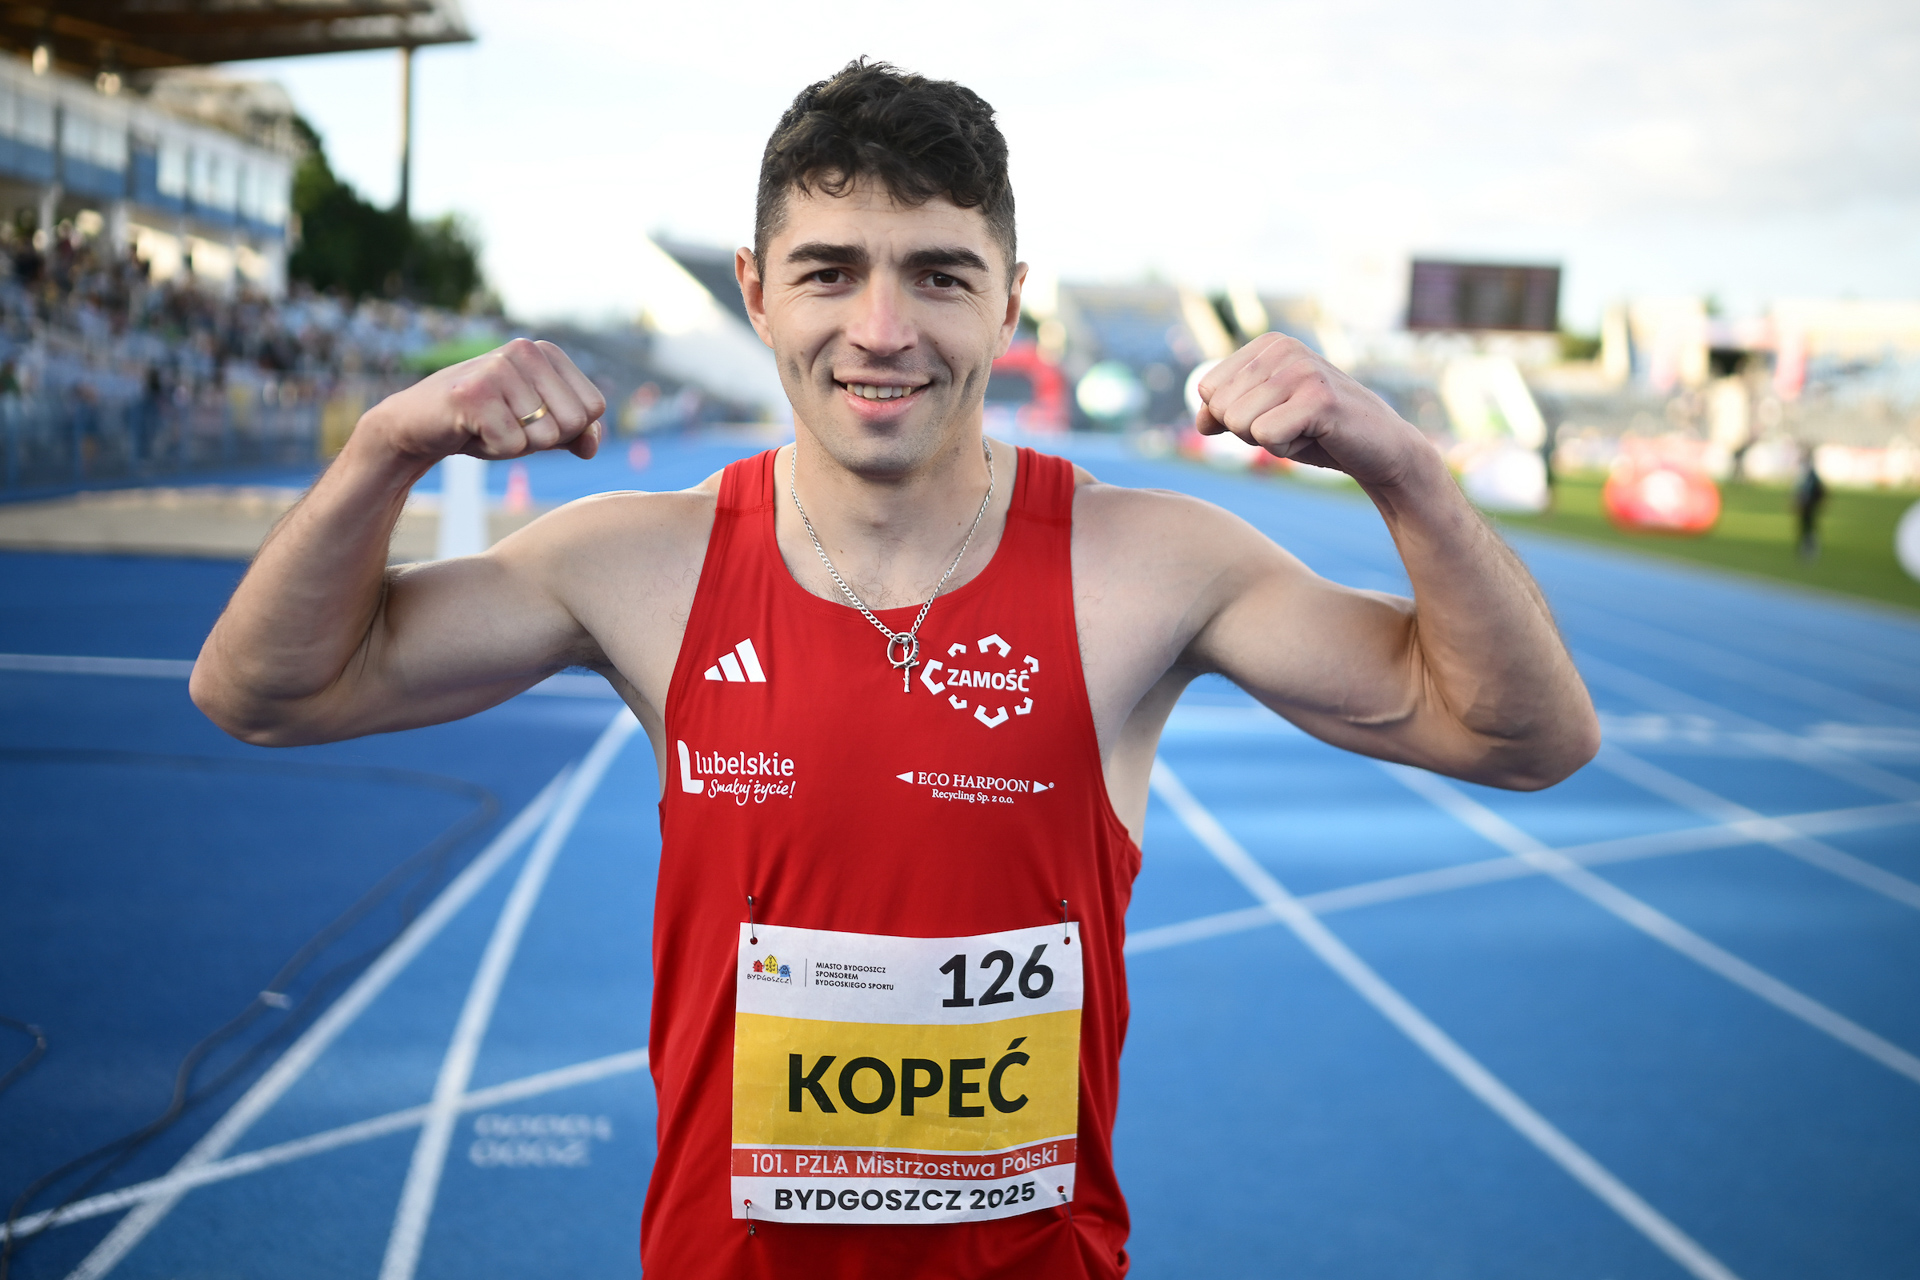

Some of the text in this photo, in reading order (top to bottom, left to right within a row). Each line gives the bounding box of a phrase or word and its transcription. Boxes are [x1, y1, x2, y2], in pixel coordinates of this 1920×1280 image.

[947, 669, 1030, 692] ZAMOŚĆ
[707, 778, 797, 806] Smakuj życie!
[918, 771, 1030, 793] ECO HARPOON
[932, 789, 975, 803] Recycling
[977, 792, 989, 804] Sp.
[999, 796, 1014, 804] o.o.
[746, 973, 790, 985] BYDGOSZCZ
[815, 962, 886, 974] MIASTO BYDGOSZCZ
[815, 971, 859, 980] SPONSOREM
[938, 943, 1055, 1008] 126
[815, 979, 894, 991] BYDGOSKIEGO SPORTU
[788, 1036, 1031, 1118] KOPEĆ
[751, 1145, 1059, 1177] 101. PZLA Mistrzostwa Polski
[774, 1181, 1036, 1211] BYDGOSZCZ 2025
